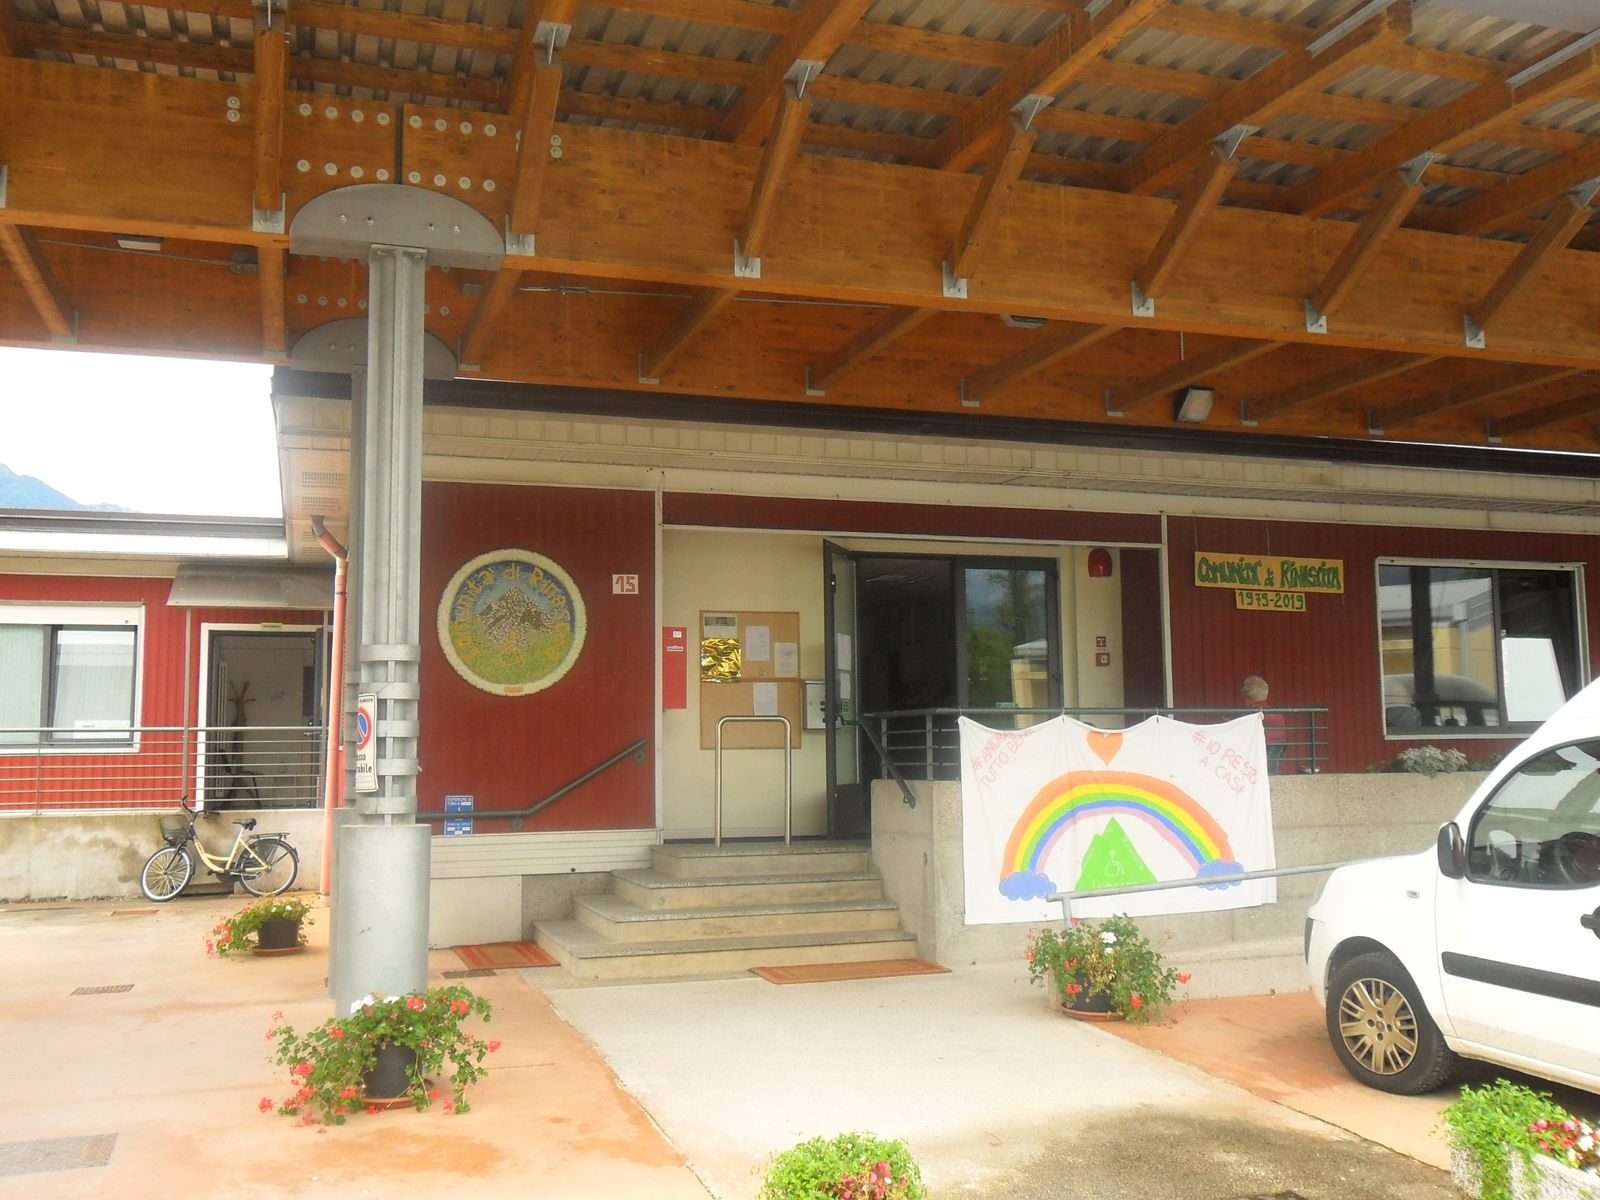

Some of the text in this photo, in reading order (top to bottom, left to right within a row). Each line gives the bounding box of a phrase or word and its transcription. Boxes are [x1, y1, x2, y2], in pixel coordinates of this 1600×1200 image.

[615, 576, 636, 592] 15
[1238, 591, 1304, 610] 1979-2019
[356, 762, 373, 774] abile
[1199, 756, 1209, 768] A
